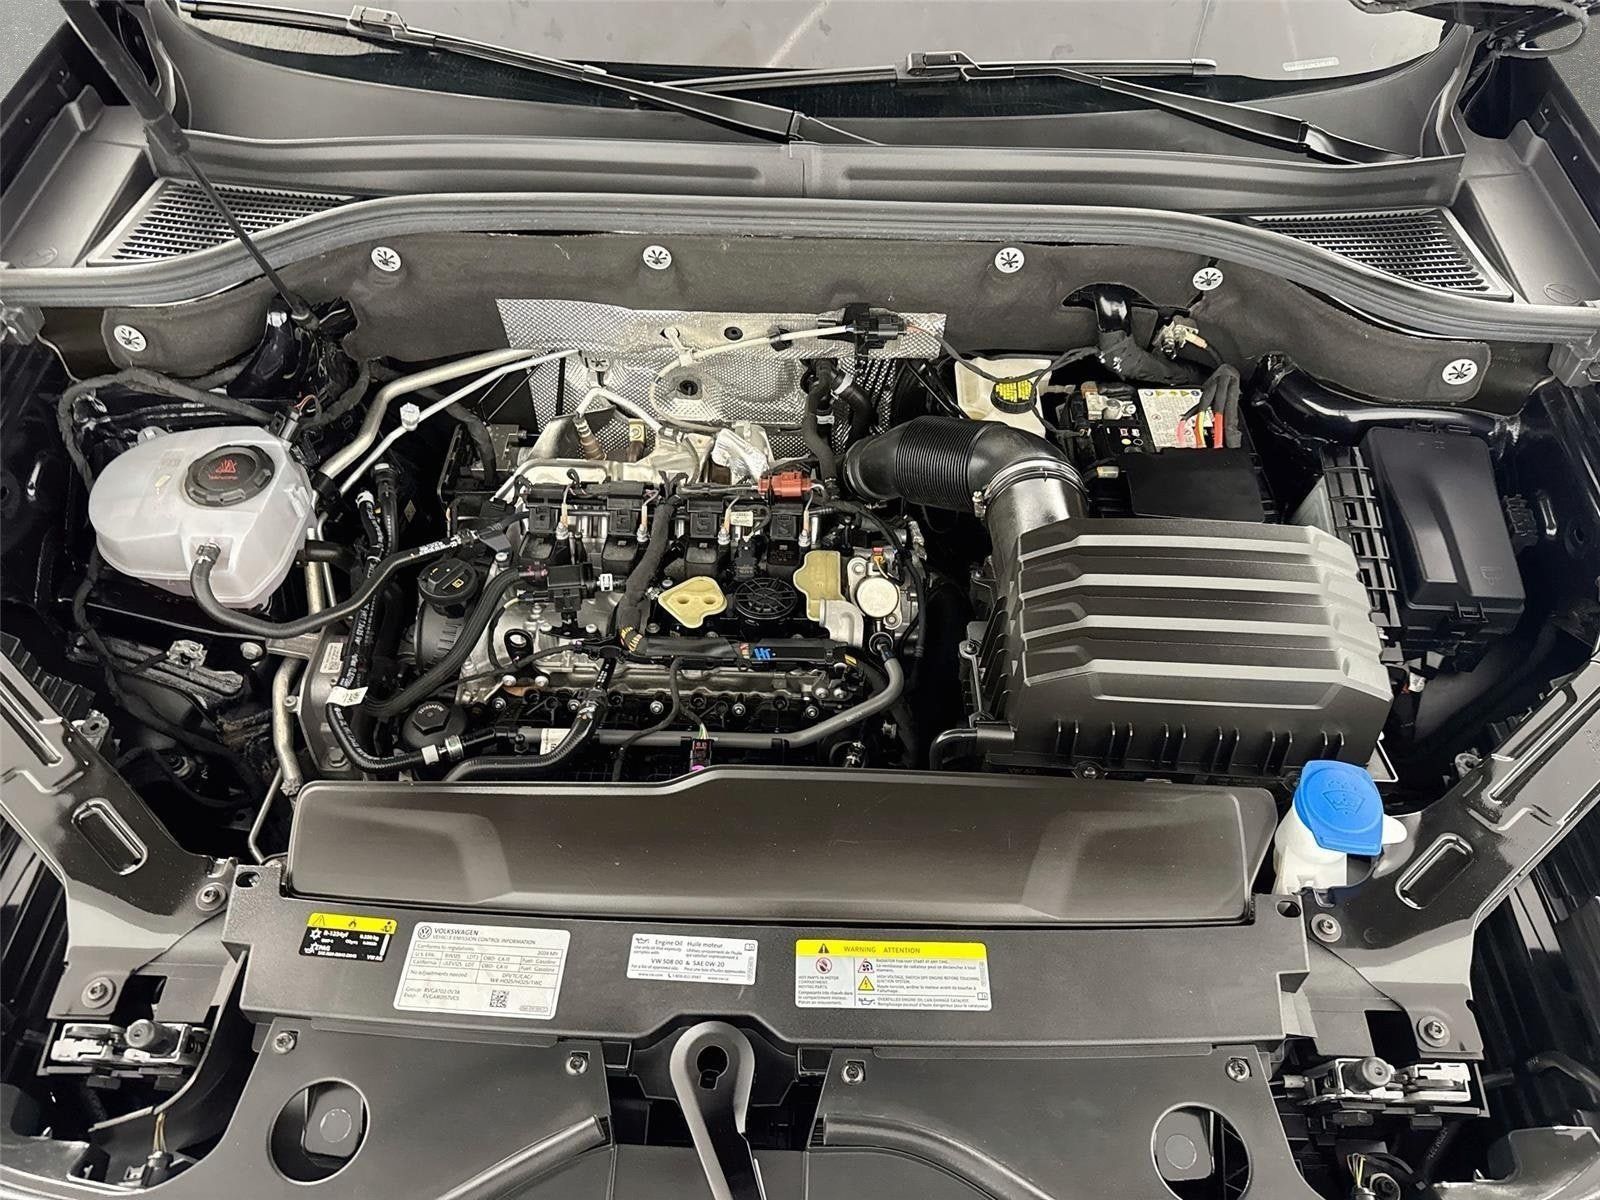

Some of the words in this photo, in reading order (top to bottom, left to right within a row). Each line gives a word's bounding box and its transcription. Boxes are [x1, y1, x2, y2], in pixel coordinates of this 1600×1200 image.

[434, 928, 479, 936] VOLKSWAGEN
[655, 939, 674, 947] Engine
[883, 946, 921, 954] ATTENTION
